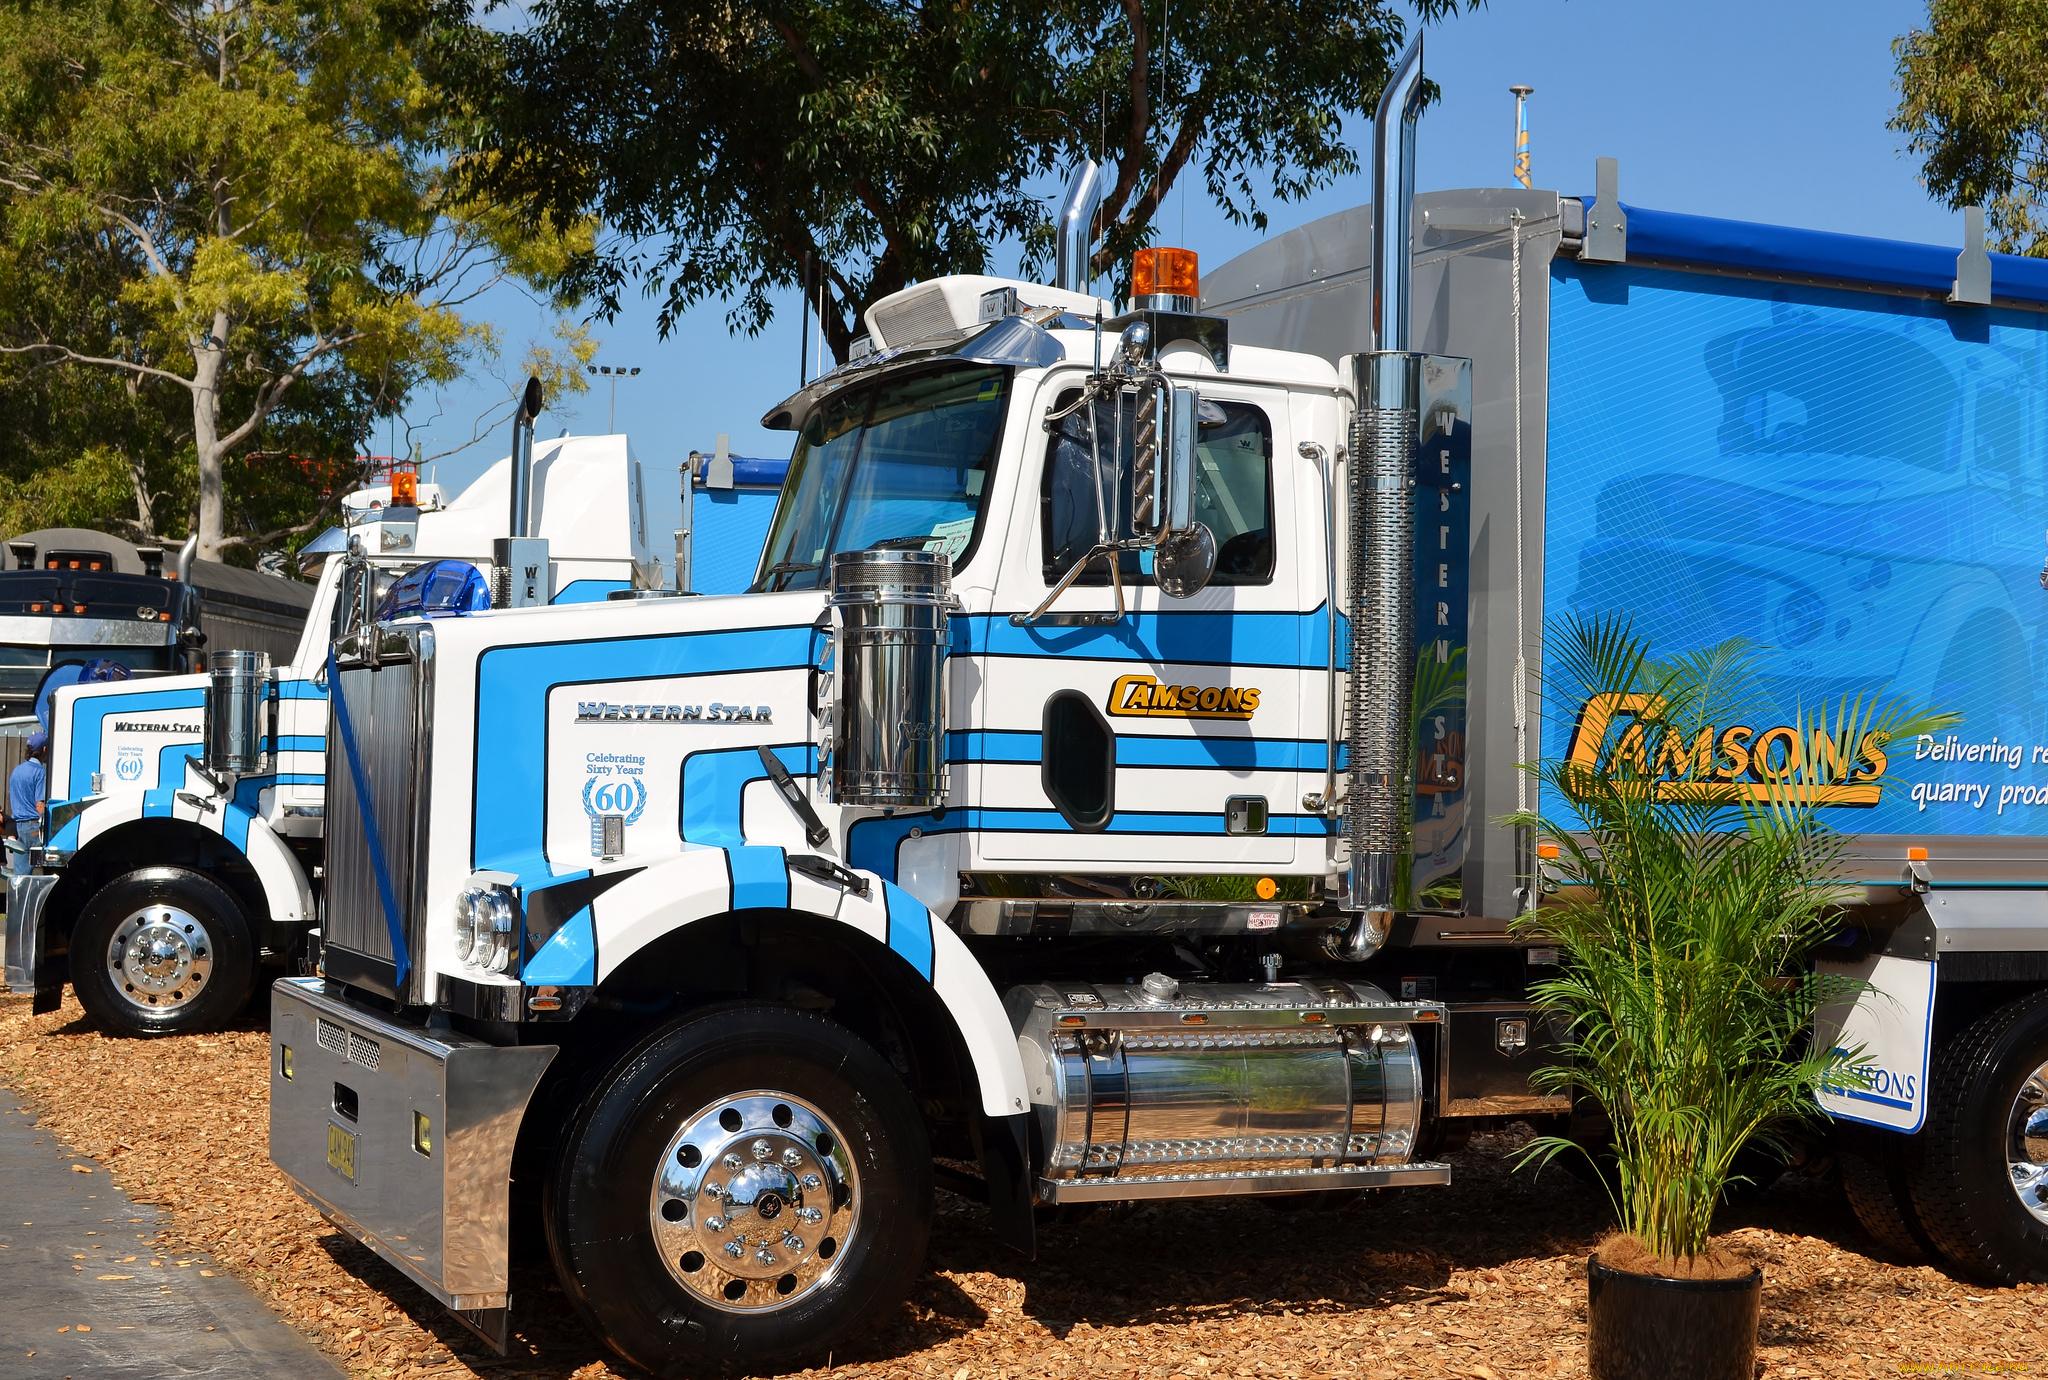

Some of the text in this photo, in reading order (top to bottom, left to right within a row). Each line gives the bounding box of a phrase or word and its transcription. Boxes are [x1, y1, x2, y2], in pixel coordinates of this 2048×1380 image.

[1434, 410, 1456, 665] WESTERN
[1106, 674, 1262, 721] CAMSONS
[577, 702, 773, 724] WESTERN STAR
[115, 722, 201, 733] WESTERN STAR
[586, 752, 645, 765] Celebrating
[1915, 734, 2023, 770] Delivering
[121, 760, 138, 774] 60
[586, 764, 644, 777] Sixty Years
[595, 783, 634, 812] 60
[1911, 783, 1991, 812] quarry
